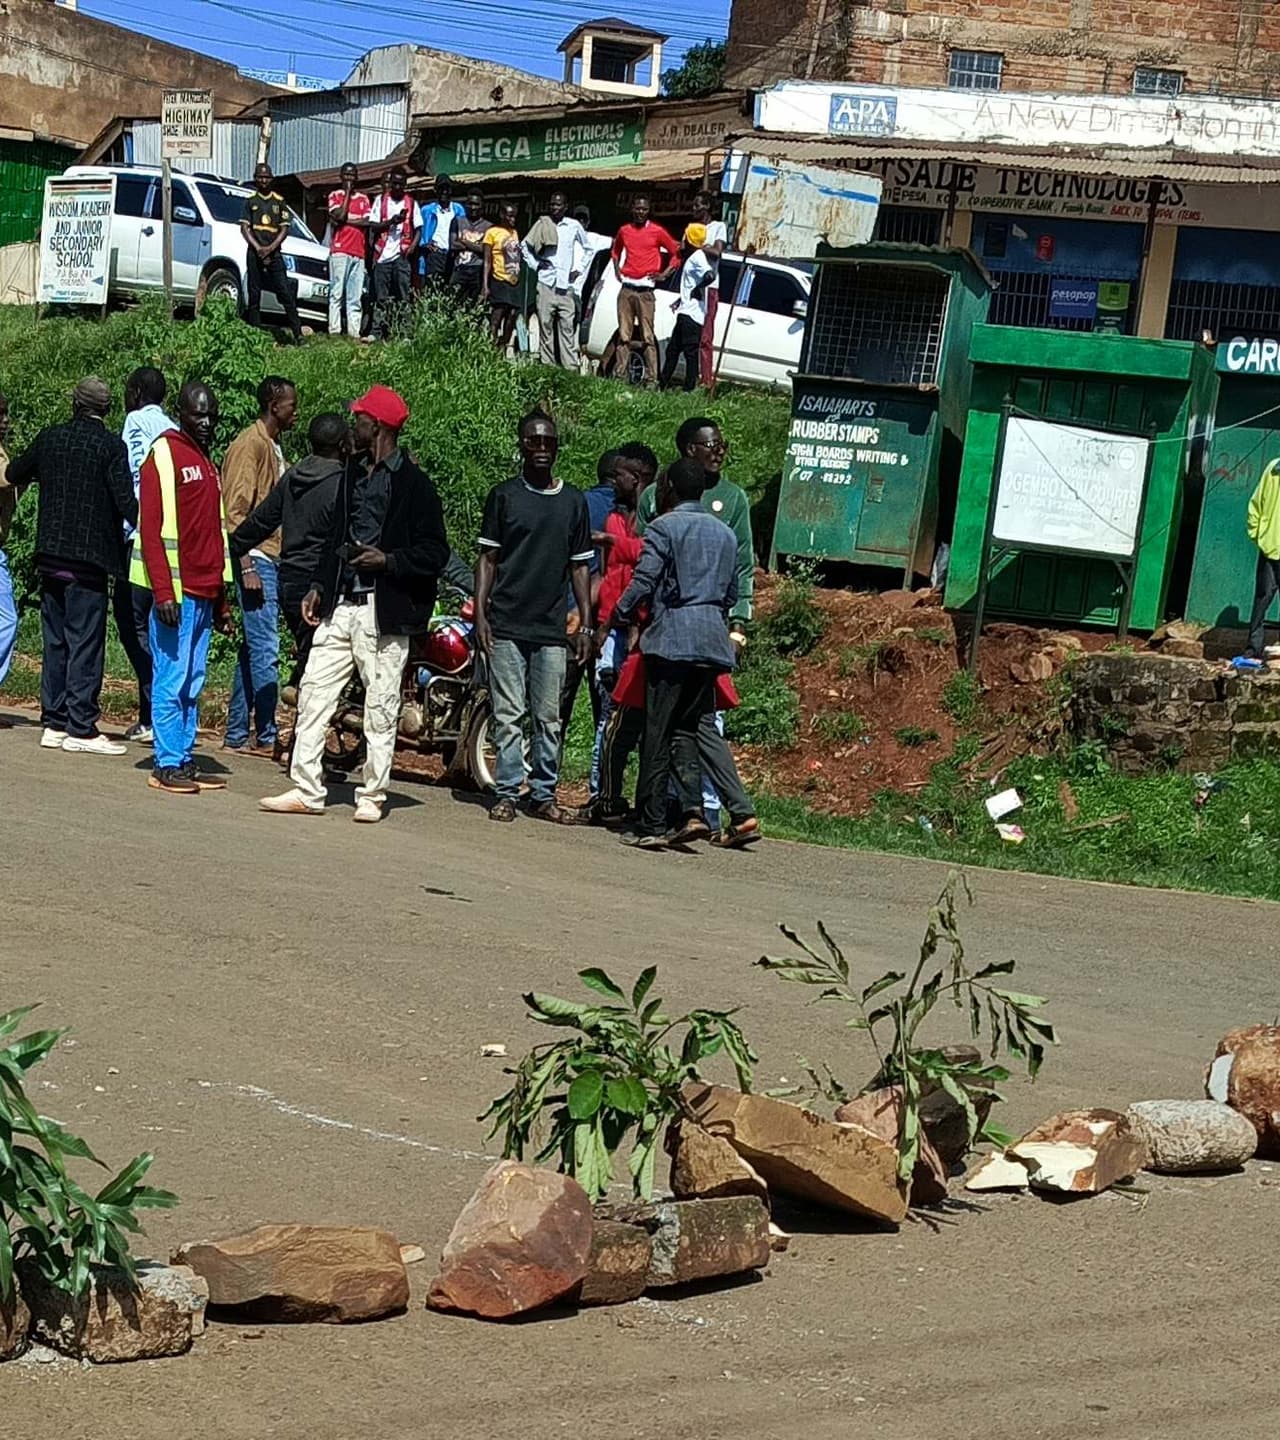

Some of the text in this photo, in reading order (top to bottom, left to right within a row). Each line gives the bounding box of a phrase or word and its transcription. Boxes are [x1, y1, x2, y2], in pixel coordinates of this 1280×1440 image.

[164, 108, 211, 124] HIGHWAY
[835, 97, 890, 124] APA
[455, 136, 531, 165] MEGA
[544, 122, 625, 144] ELECTRICALS
[544, 141, 620, 162] ELECTRONICS
[48, 200, 79, 217] WISDOM
[54, 220, 103, 236] AND JUNIOR
[49, 235, 105, 252] SECONDARY
[56, 251, 95, 268] SCHOOL
[815, 445, 854, 460] BOARDS
[856, 449, 899, 465] WRITING
